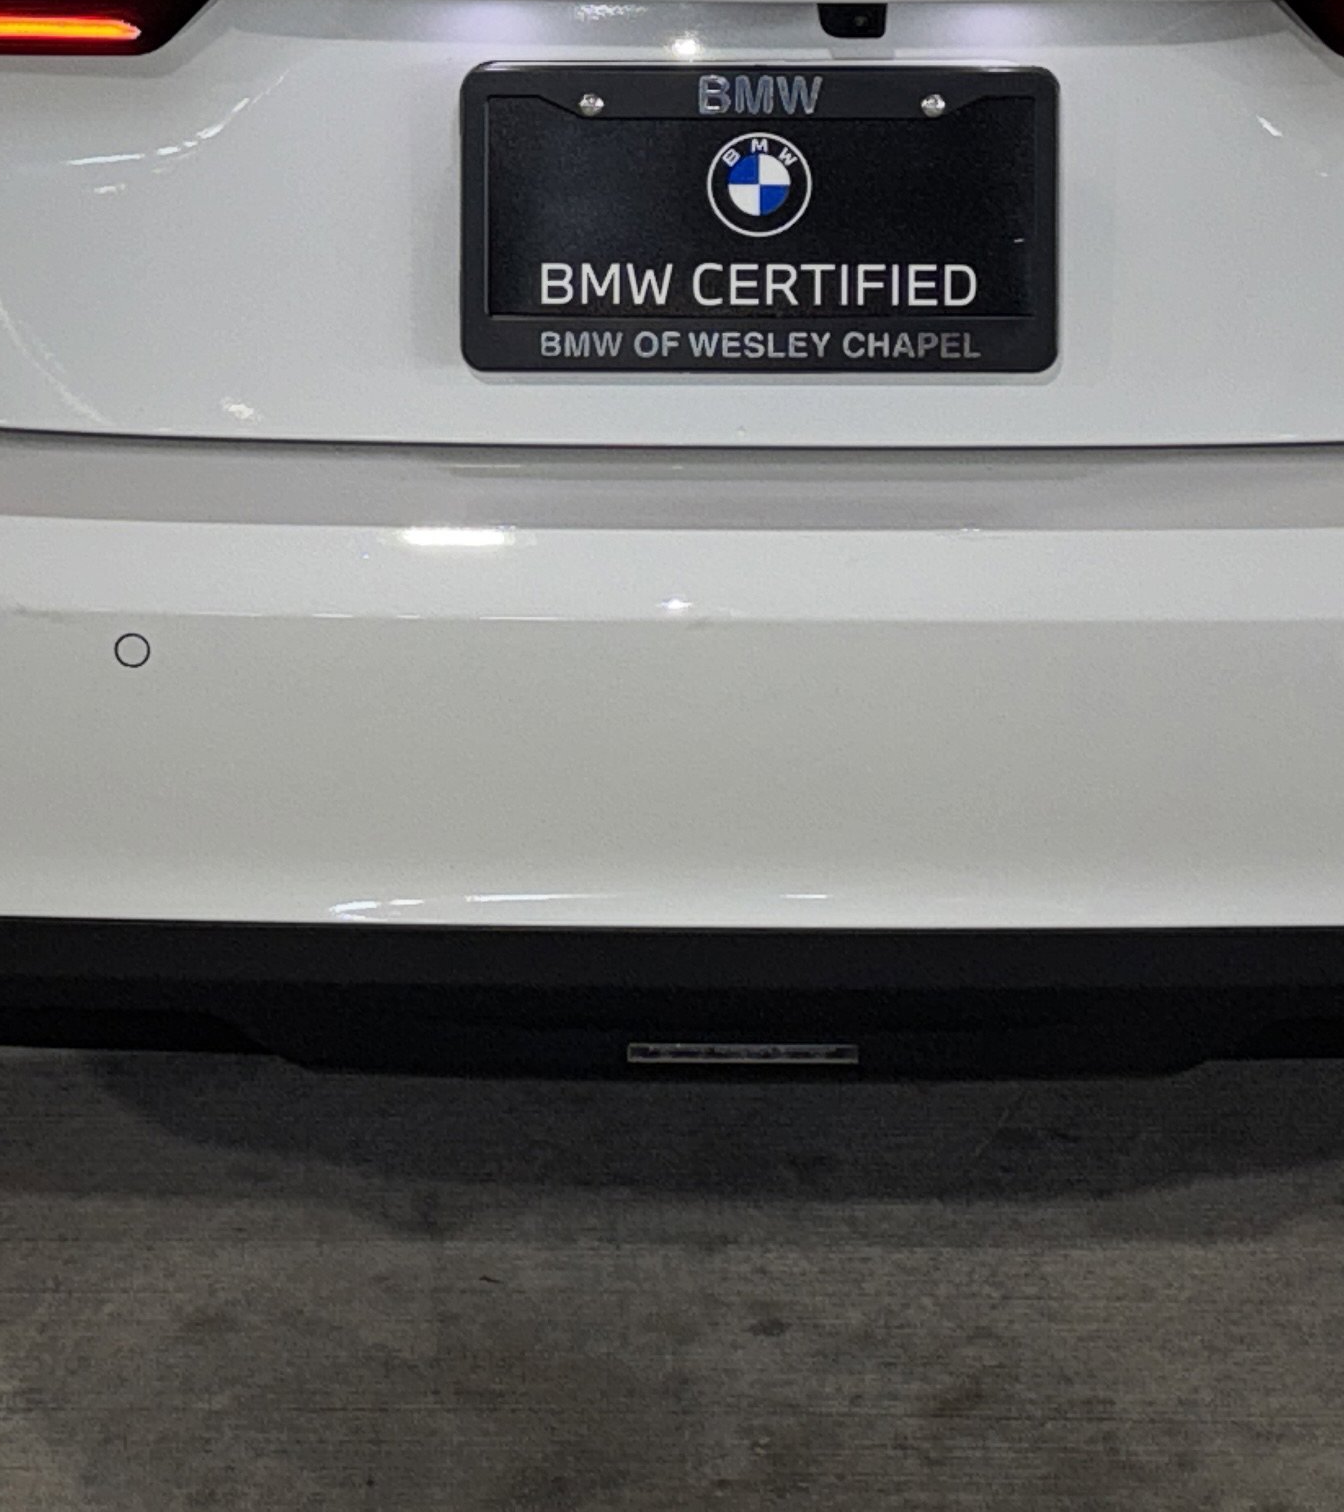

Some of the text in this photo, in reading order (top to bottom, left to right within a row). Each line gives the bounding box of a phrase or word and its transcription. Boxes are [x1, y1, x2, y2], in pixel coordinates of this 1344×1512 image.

[698, 74, 824, 116] BMW
[721, 138, 798, 168] BMW
[540, 262, 977, 307] BMW CERTIFIED
[540, 330, 981, 359] BMW OF WESLEY CHAPEL
